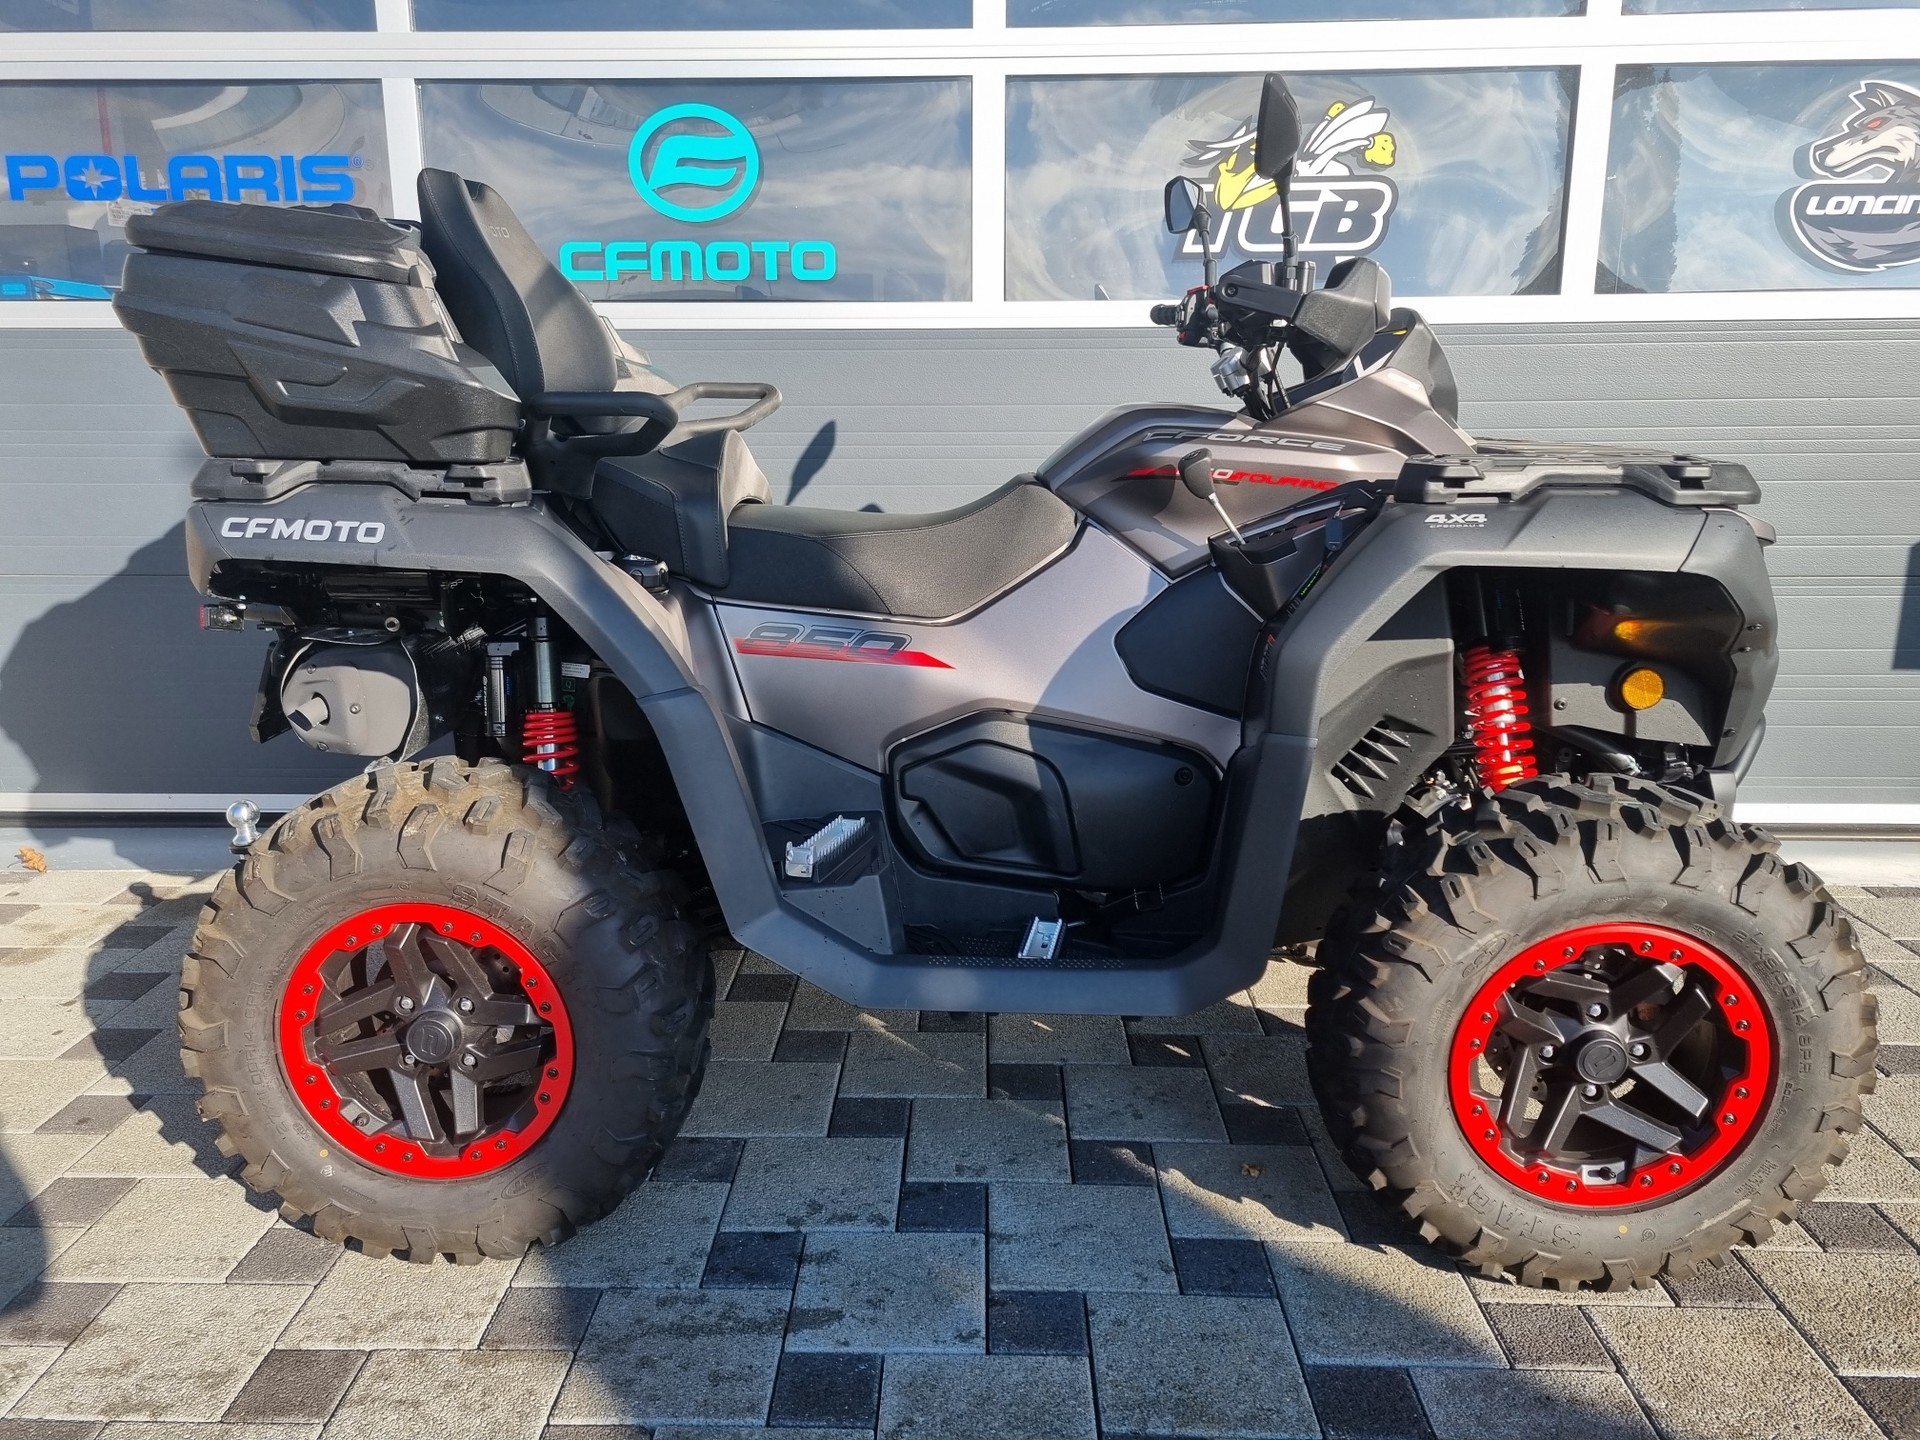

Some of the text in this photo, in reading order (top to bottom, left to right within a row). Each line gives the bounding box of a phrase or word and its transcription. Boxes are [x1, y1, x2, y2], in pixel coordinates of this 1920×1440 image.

[559, 240, 838, 281] CFMOTO
[1142, 430, 1347, 453] CFORCE
[221, 517, 386, 544] CFMOTO
[740, 621, 913, 658] 850
